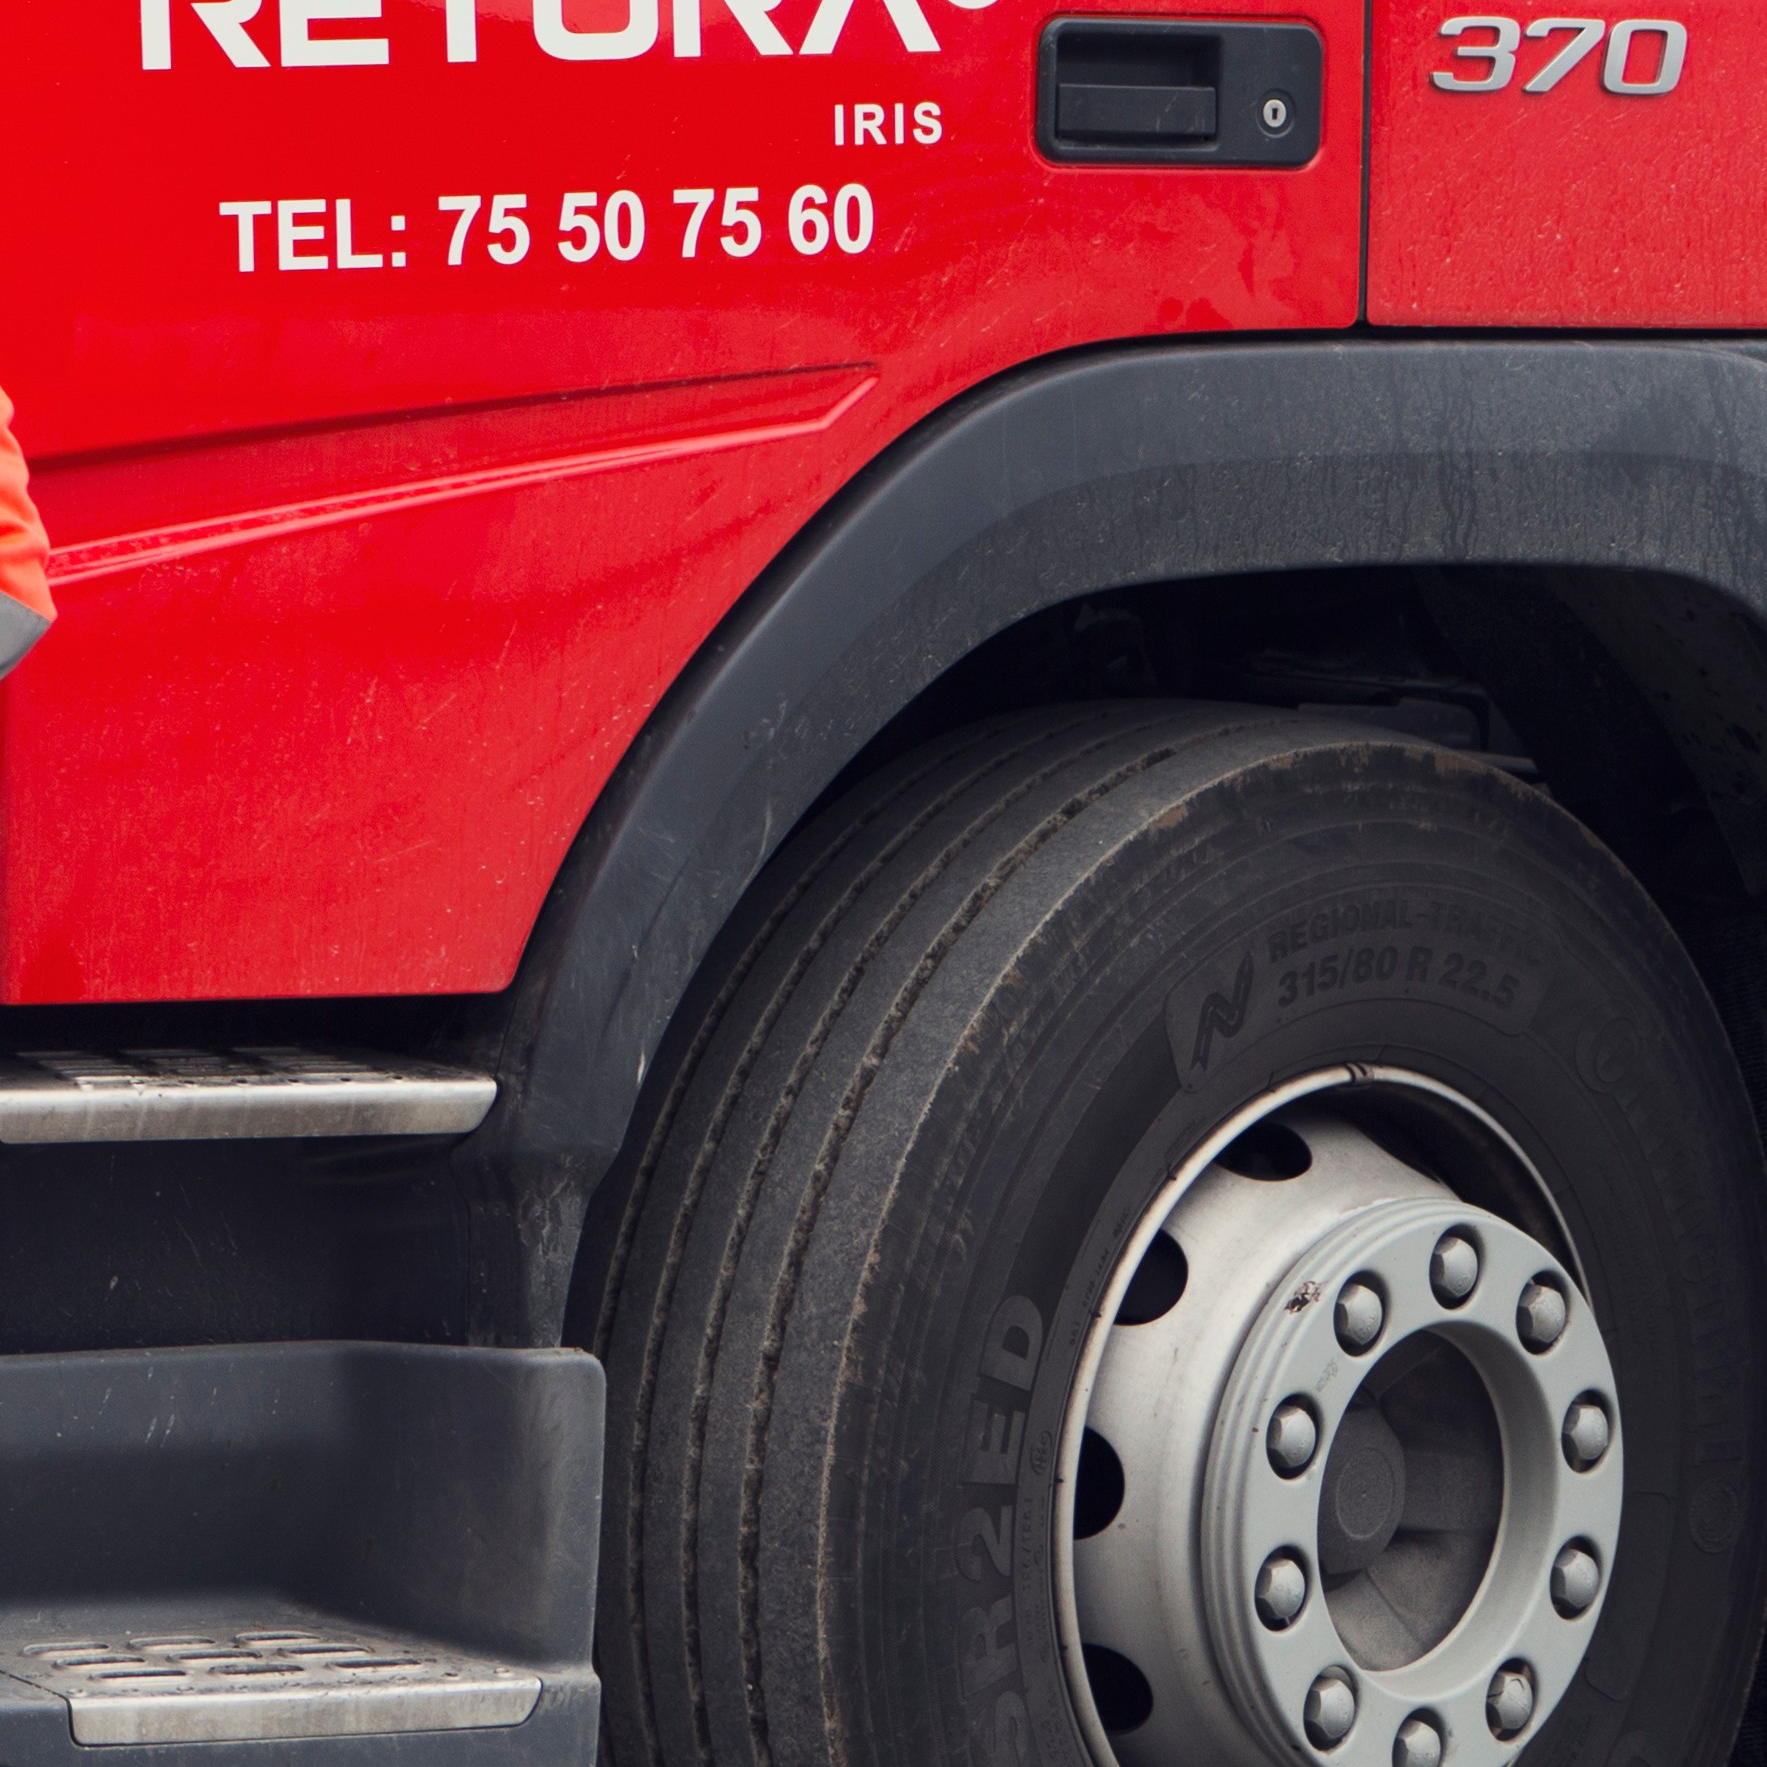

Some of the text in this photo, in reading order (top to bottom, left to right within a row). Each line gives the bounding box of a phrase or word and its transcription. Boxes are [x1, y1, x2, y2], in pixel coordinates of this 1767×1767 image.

[1429, 16, 1688, 96] 370
[834, 102, 944, 146] IRIS
[219, 182, 875, 273] TEL: 75 50 75 60
[1277, 946, 1521, 1011] 315/80 R 22.5
